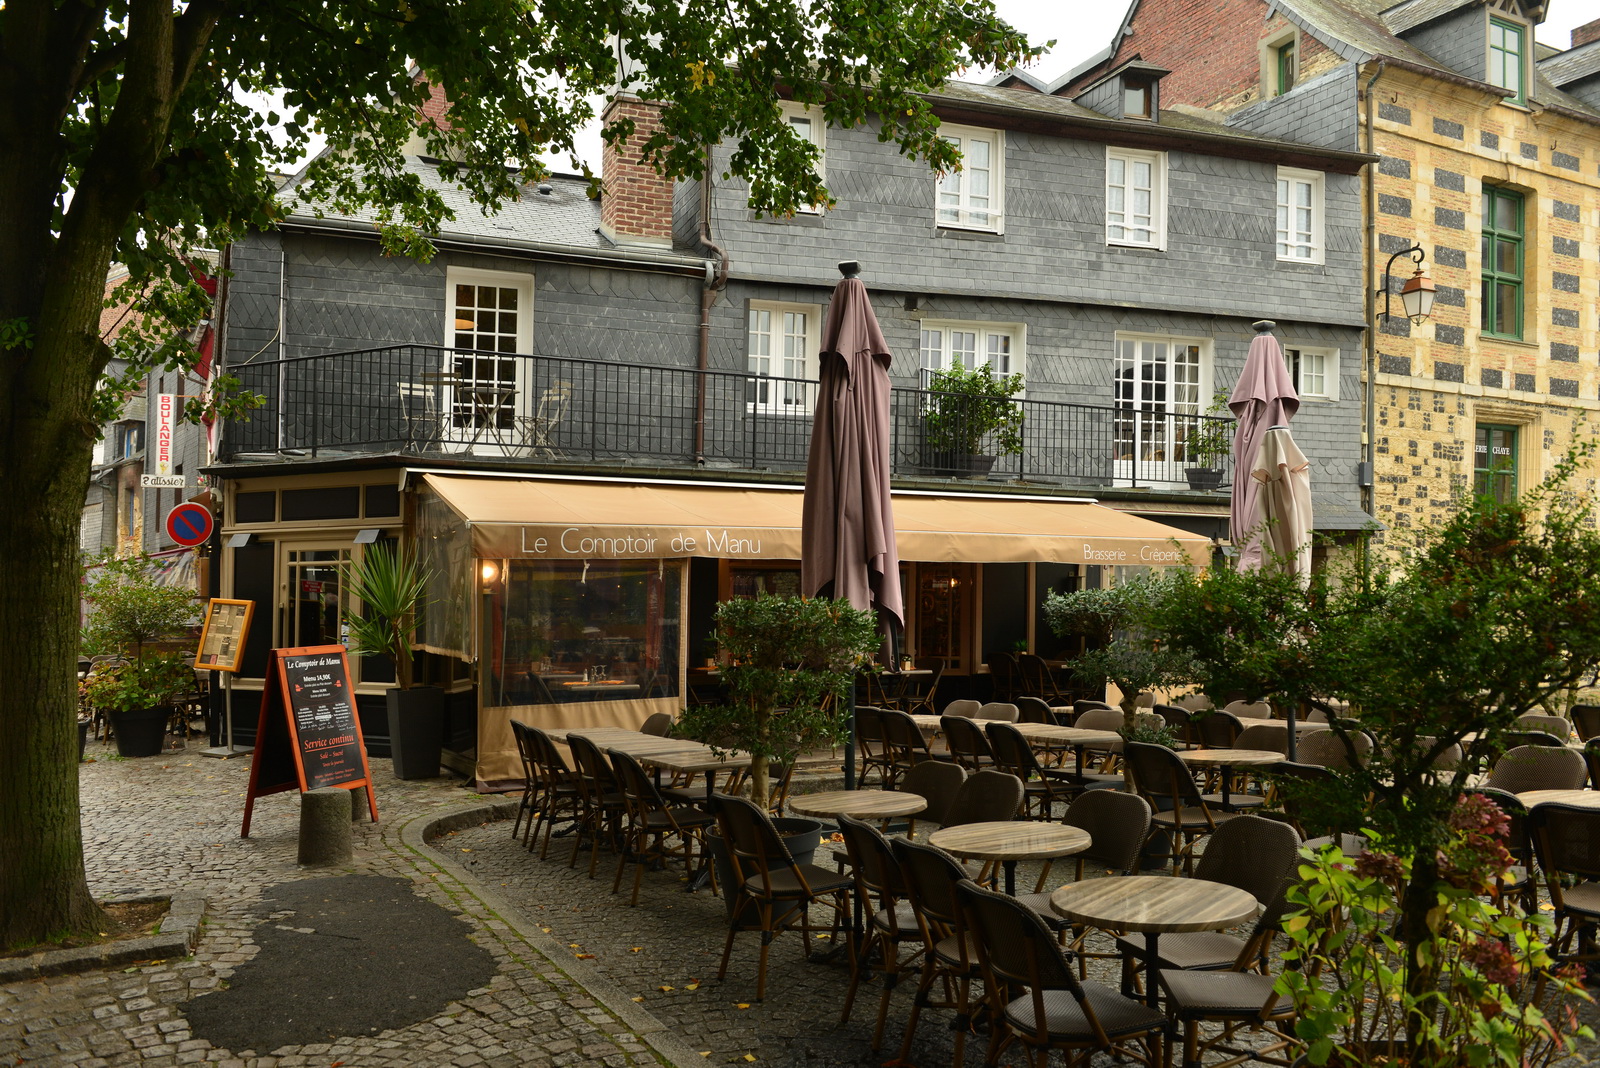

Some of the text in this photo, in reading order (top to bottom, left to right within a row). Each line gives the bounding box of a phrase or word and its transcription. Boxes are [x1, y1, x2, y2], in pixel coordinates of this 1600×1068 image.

[160, 396, 170, 462] BOULANGER
[1475, 445, 1510, 455] ERIE CHAYE
[522, 527, 760, 557] Le Comptoir de Manu
[1083, 543, 1127, 561] Brasserie
[1140, 545, 1182, 562] Crêperie
[295, 659, 318, 670] Comptoir
[319, 658, 325, 666] de
[304, 734, 354, 750] Service continu
